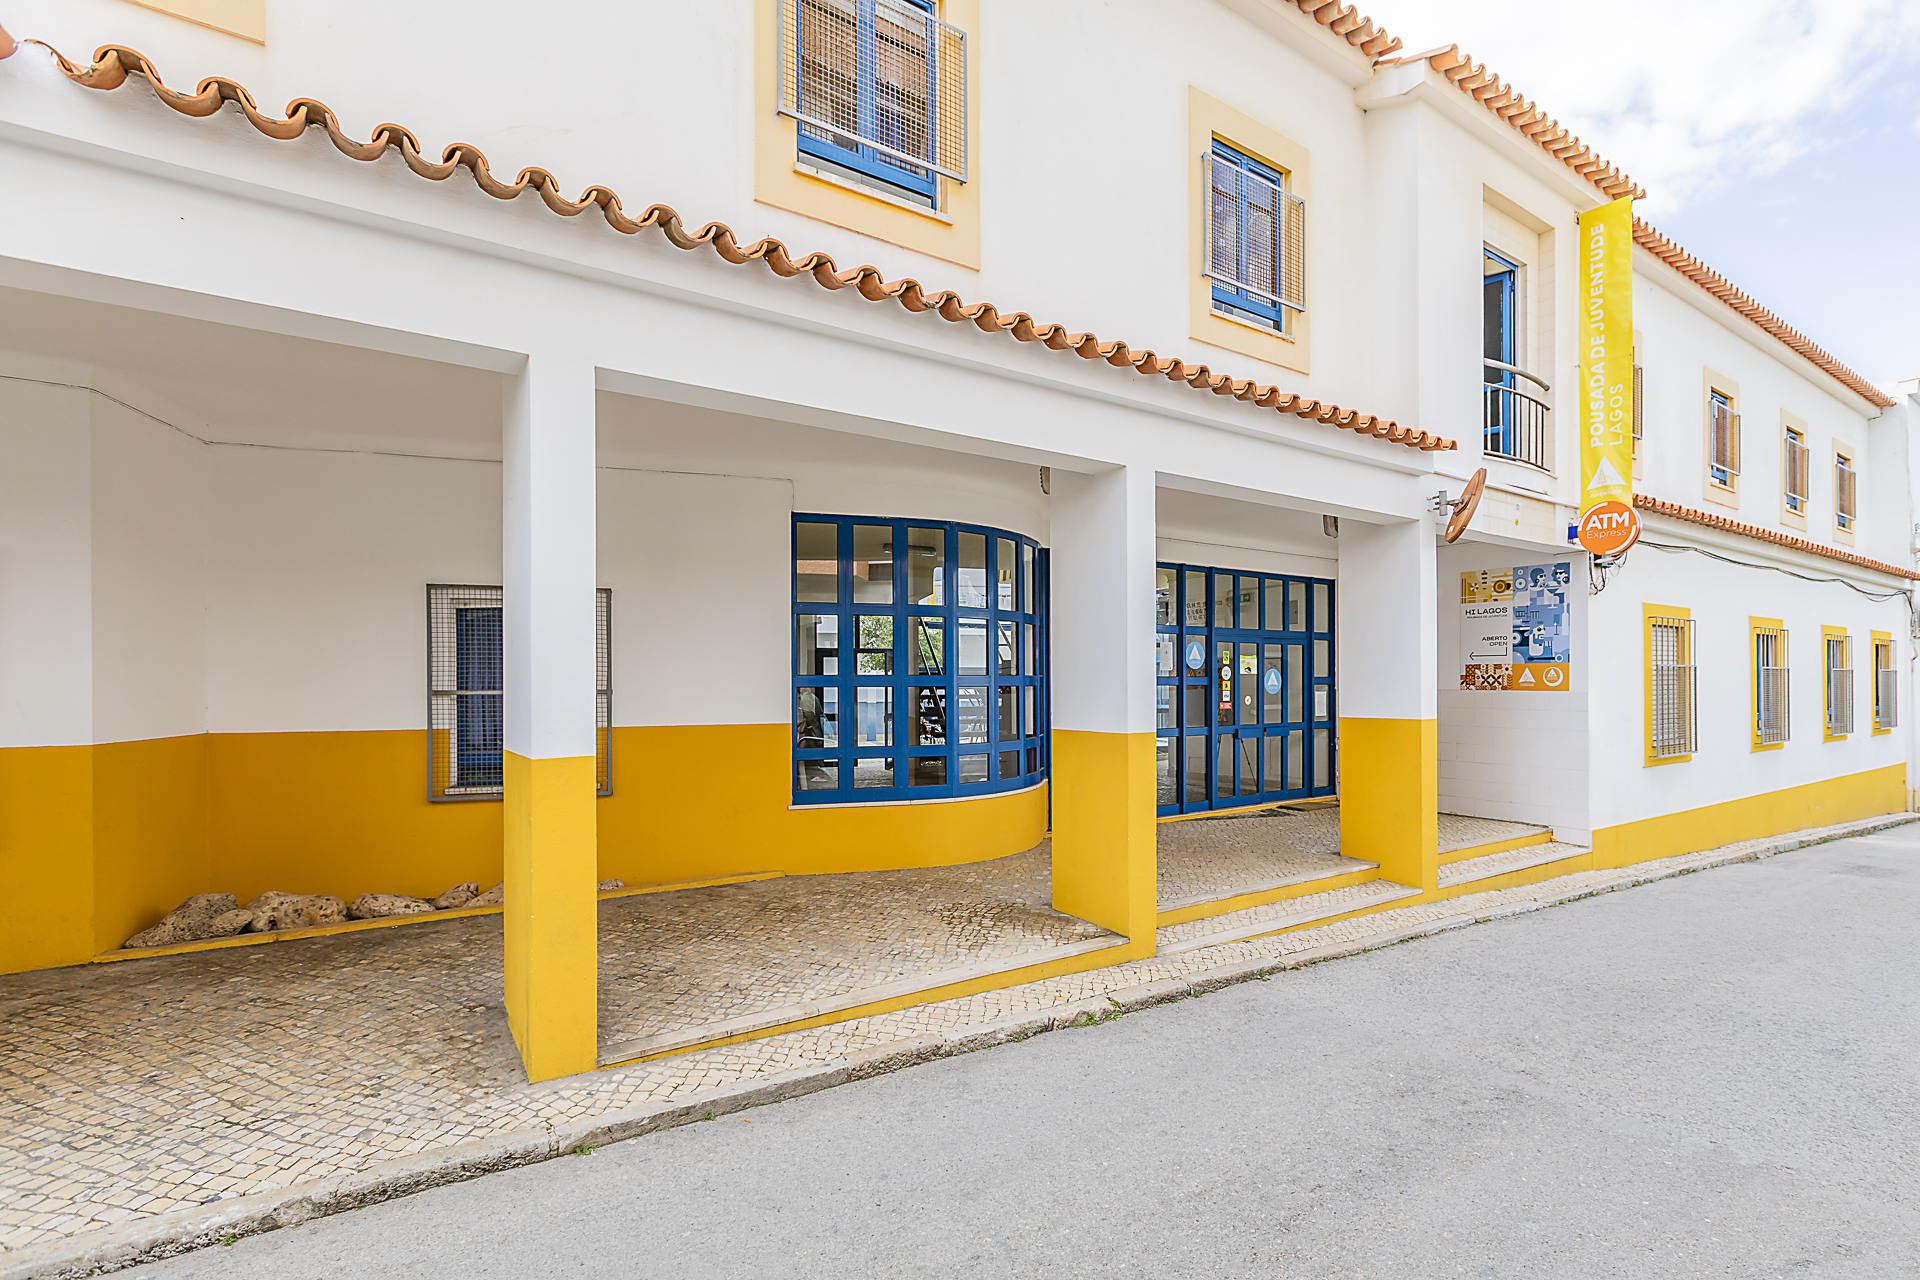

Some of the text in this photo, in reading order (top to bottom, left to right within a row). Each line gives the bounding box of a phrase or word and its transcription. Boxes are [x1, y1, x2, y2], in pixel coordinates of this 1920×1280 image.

[1590, 223, 1605, 448] POUSADA DE JUVENTUDE
[1609, 384, 1623, 446] LAGOS
[1589, 489, 1622, 498] JUVENTUDE
[1586, 511, 1629, 531] ATM
[1587, 529, 1627, 539] Express
